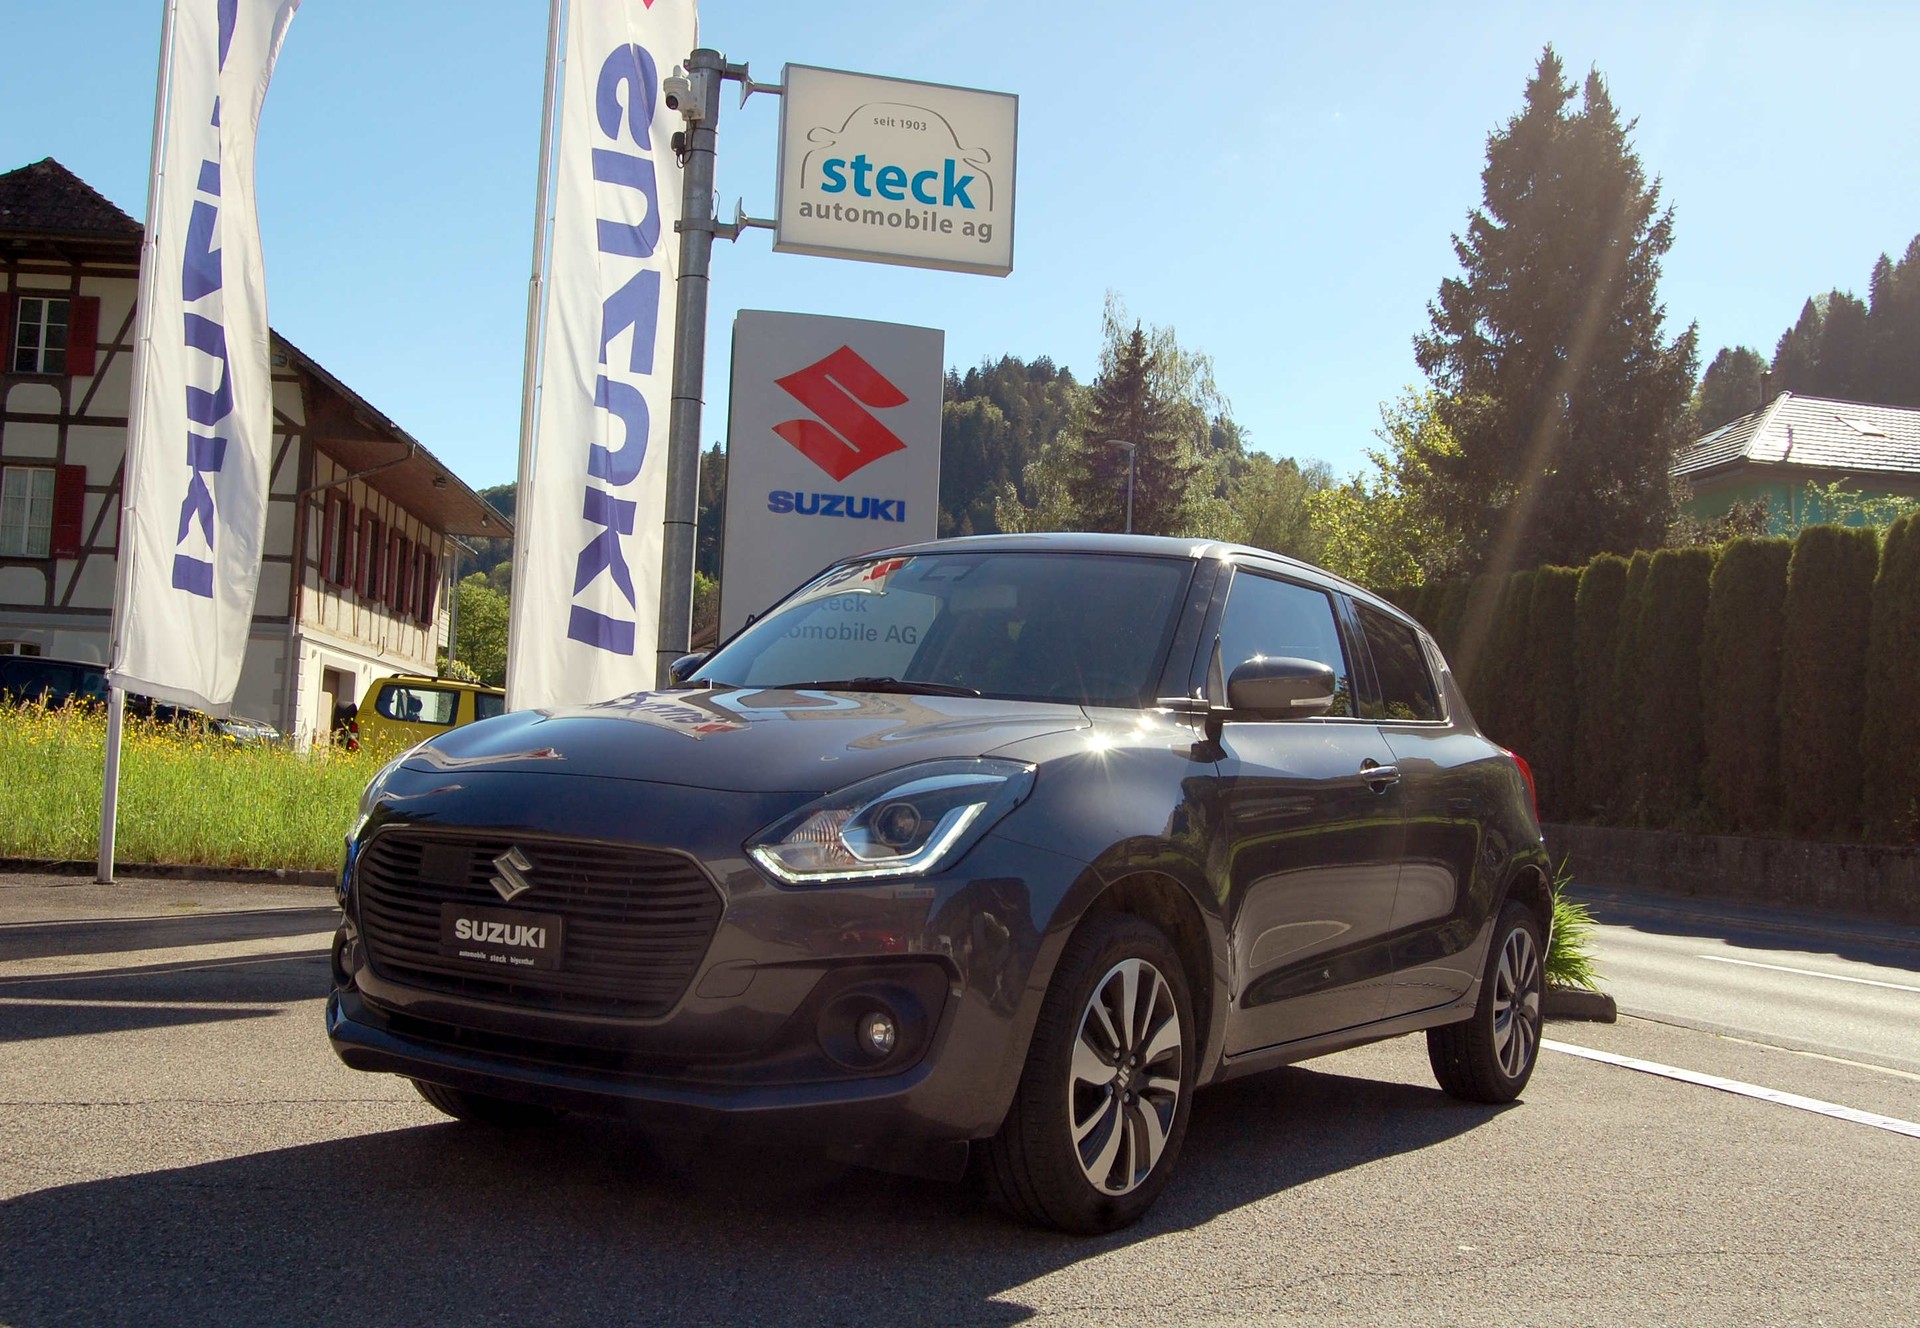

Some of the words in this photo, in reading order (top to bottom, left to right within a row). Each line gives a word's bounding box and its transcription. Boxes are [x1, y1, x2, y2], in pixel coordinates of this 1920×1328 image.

[873, 116, 895, 127] seit
[900, 119, 927, 131] 1903
[820, 154, 976, 209] steck
[799, 201, 953, 234] automobile
[962, 221, 992, 243] ag
[767, 490, 905, 522] SUZUKI
[821, 593, 867, 613] eck
[884, 624, 917, 644] AG
[455, 918, 546, 949] SUZUKI
[459, 950, 487, 960] automobile
